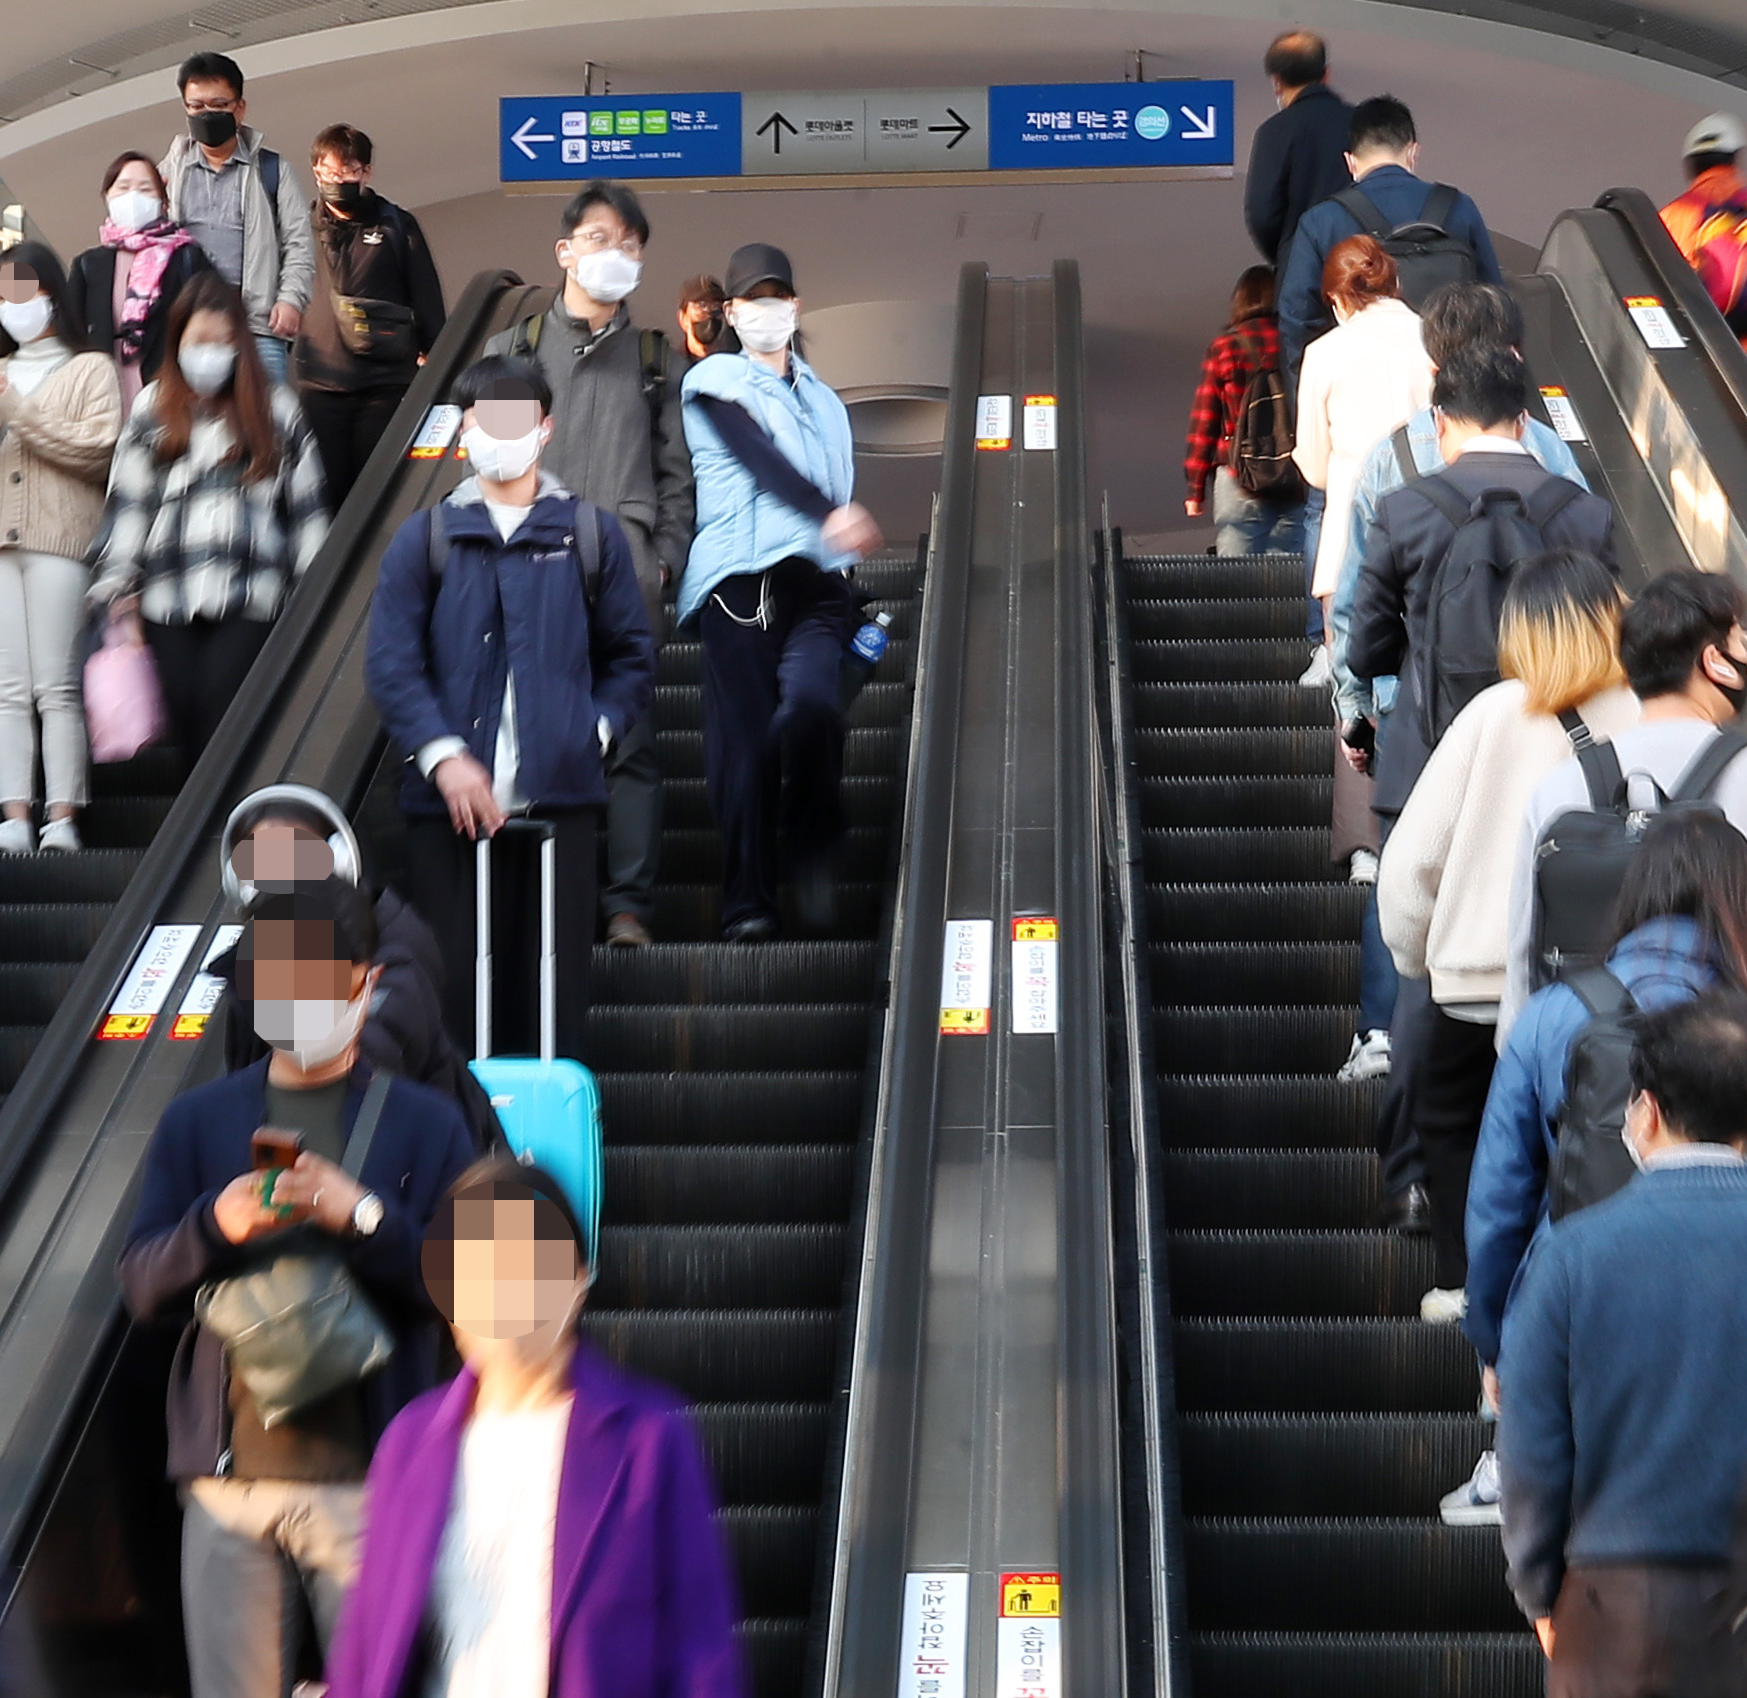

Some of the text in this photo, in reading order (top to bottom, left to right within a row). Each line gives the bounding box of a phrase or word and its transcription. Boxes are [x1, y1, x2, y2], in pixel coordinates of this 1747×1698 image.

[1026, 110, 1129, 130] 지하철 타는 곳
[1022, 132, 1049, 142] Metro
[918, 1580, 948, 1651] 잡아주세요
[1019, 1626, 1045, 1683] 손잡이를
[912, 1656, 950, 1675] 꼭
